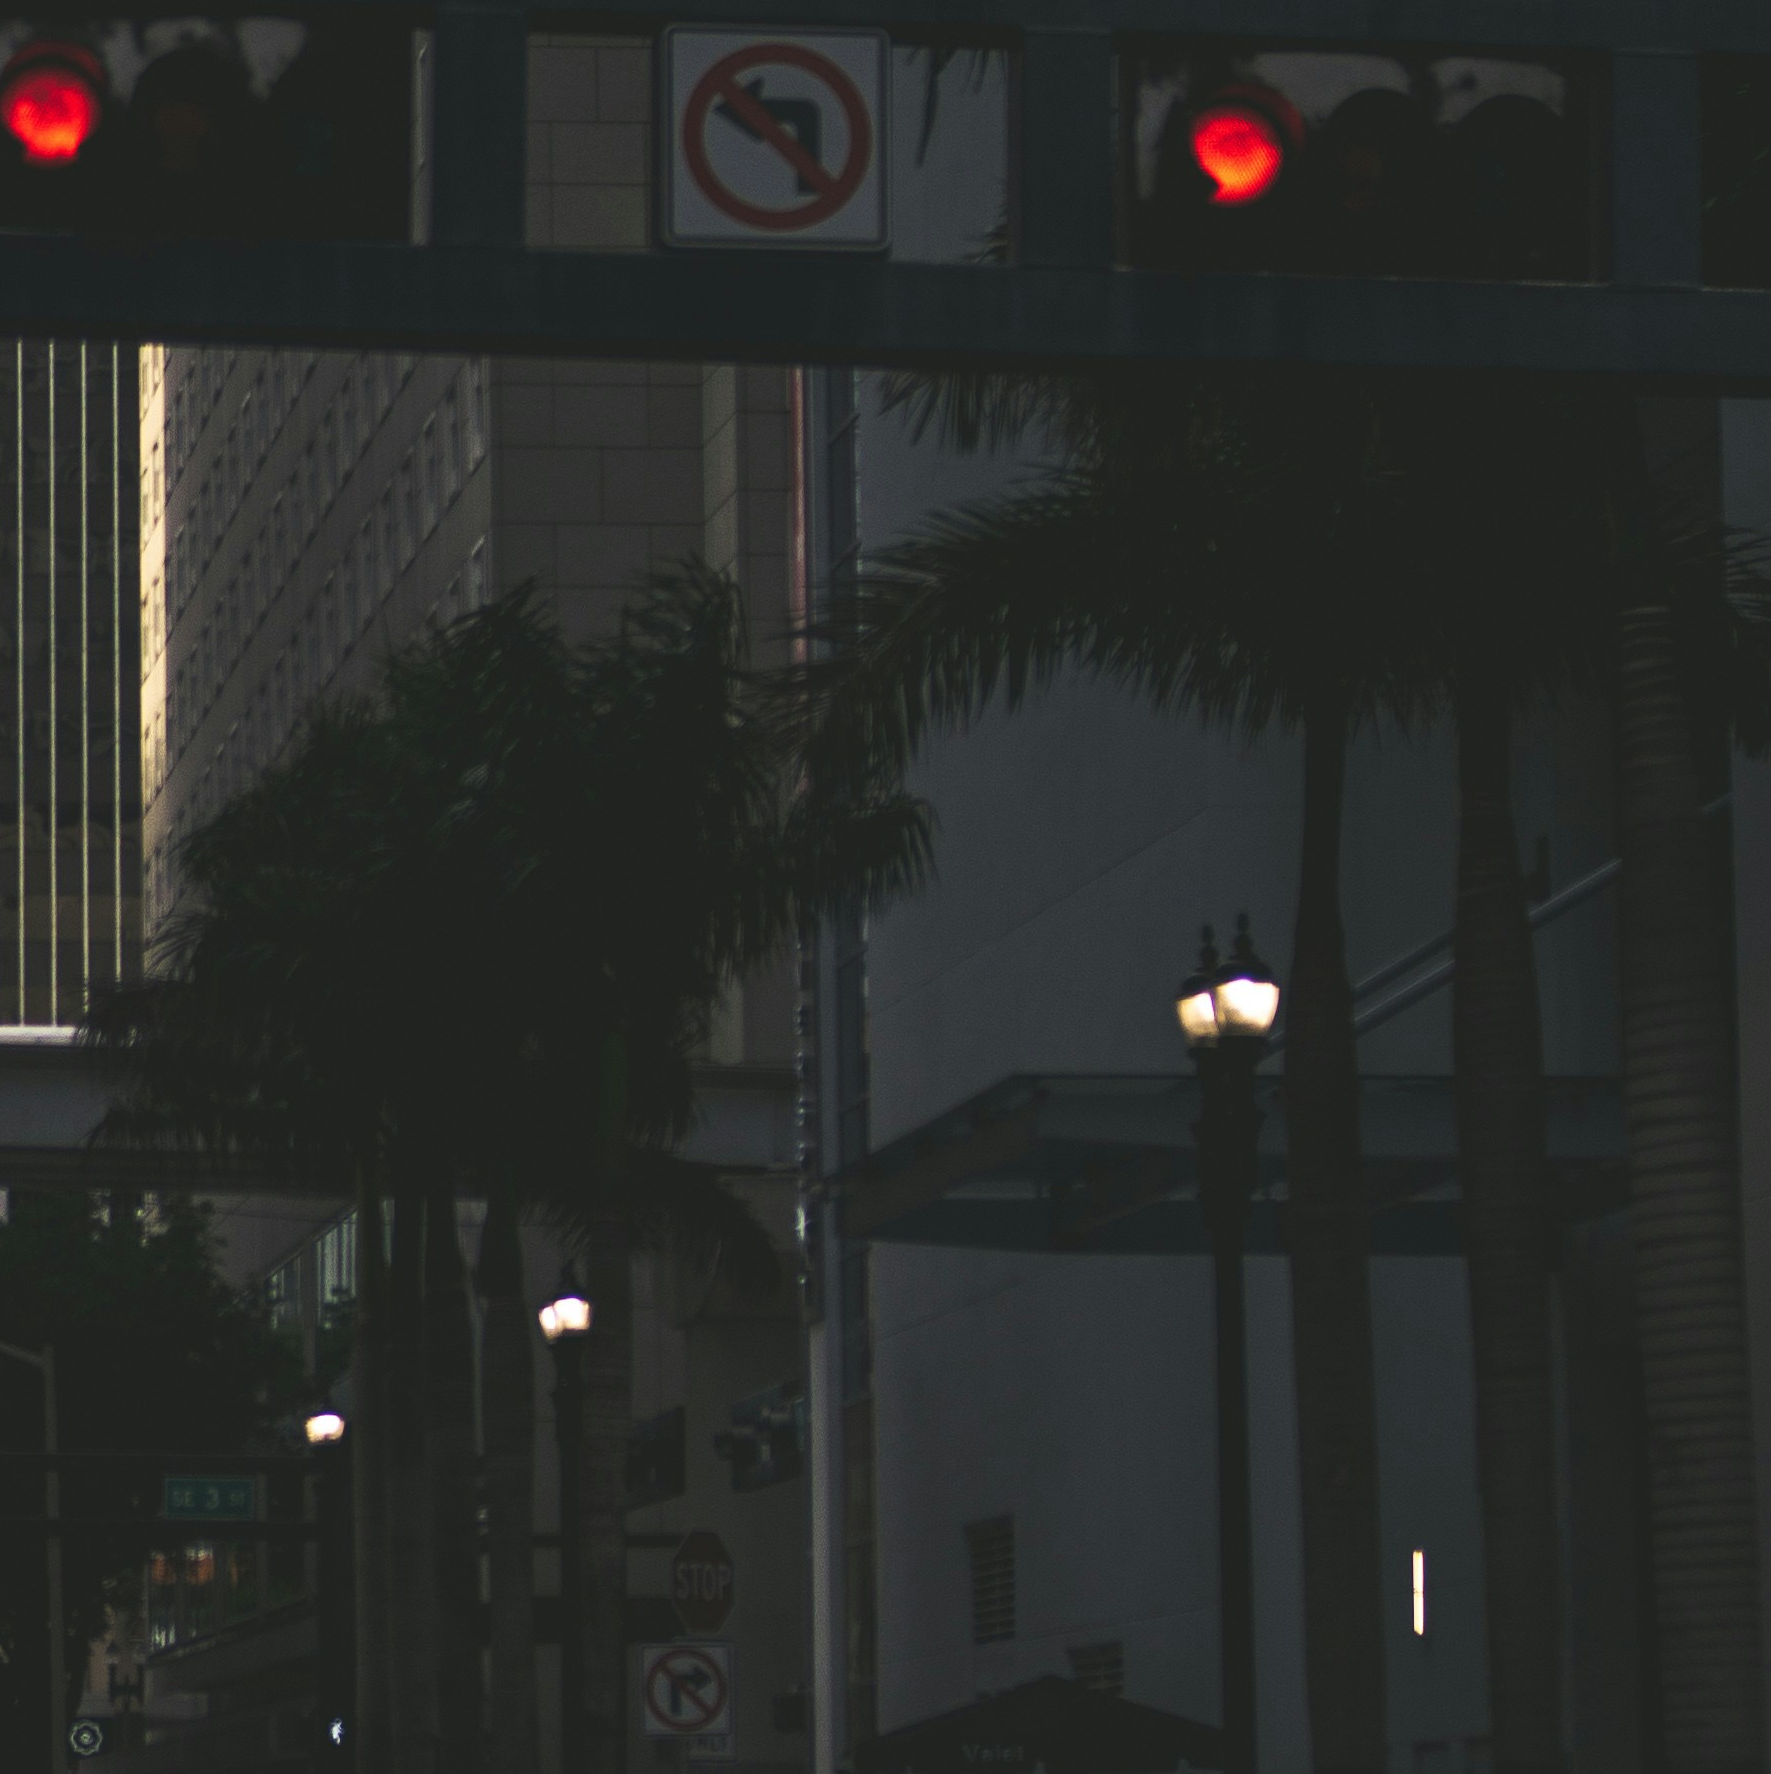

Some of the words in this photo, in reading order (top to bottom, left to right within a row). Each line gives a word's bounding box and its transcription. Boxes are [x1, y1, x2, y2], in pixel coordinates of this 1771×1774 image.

[172, 1489, 194, 1507] SE
[204, 1487, 219, 1510] 3
[676, 1561, 732, 1602] STOP
[962, 1744, 1025, 1763] Valet
